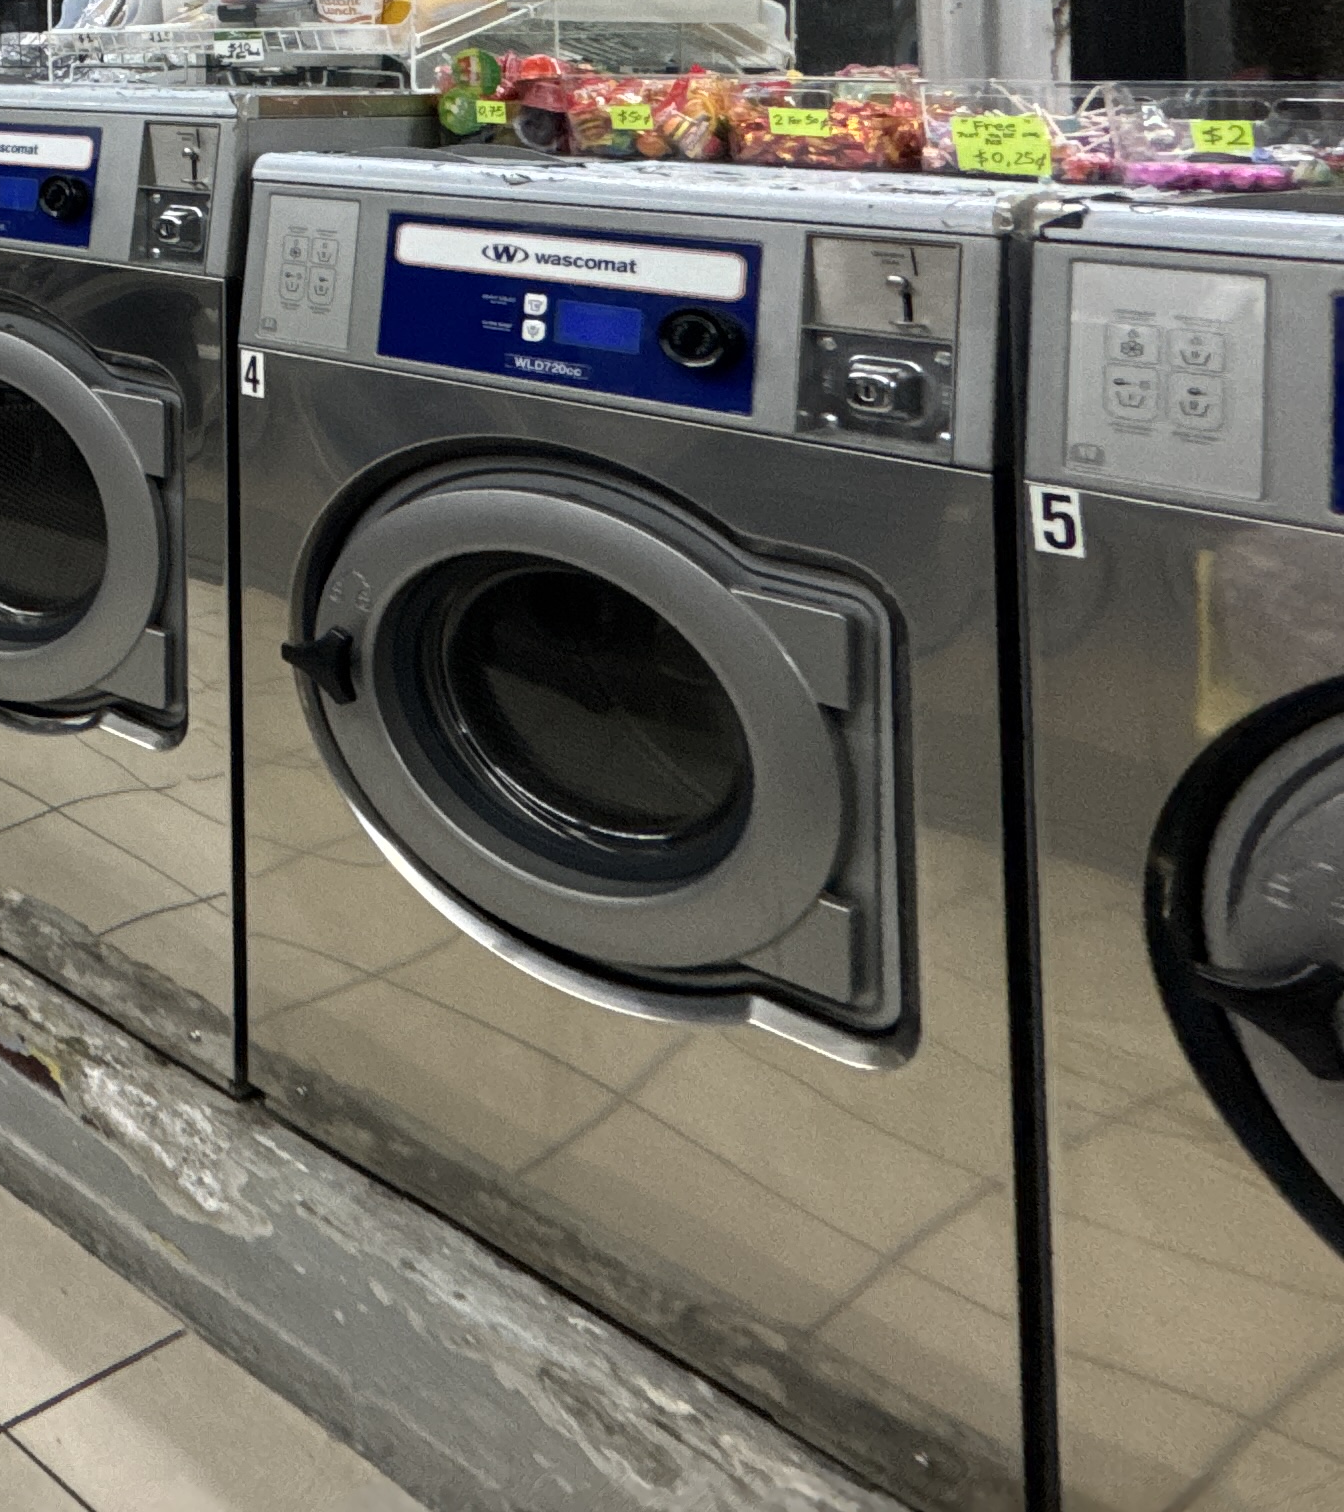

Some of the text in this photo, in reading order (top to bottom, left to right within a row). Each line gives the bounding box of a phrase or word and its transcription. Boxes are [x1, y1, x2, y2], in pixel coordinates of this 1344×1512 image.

[1201, 124, 1250, 147] $2
[533, 251, 638, 275] wascomat
[243, 358, 261, 395] 4
[513, 356, 583, 377] WLD720cc
[1043, 493, 1077, 550] 5
